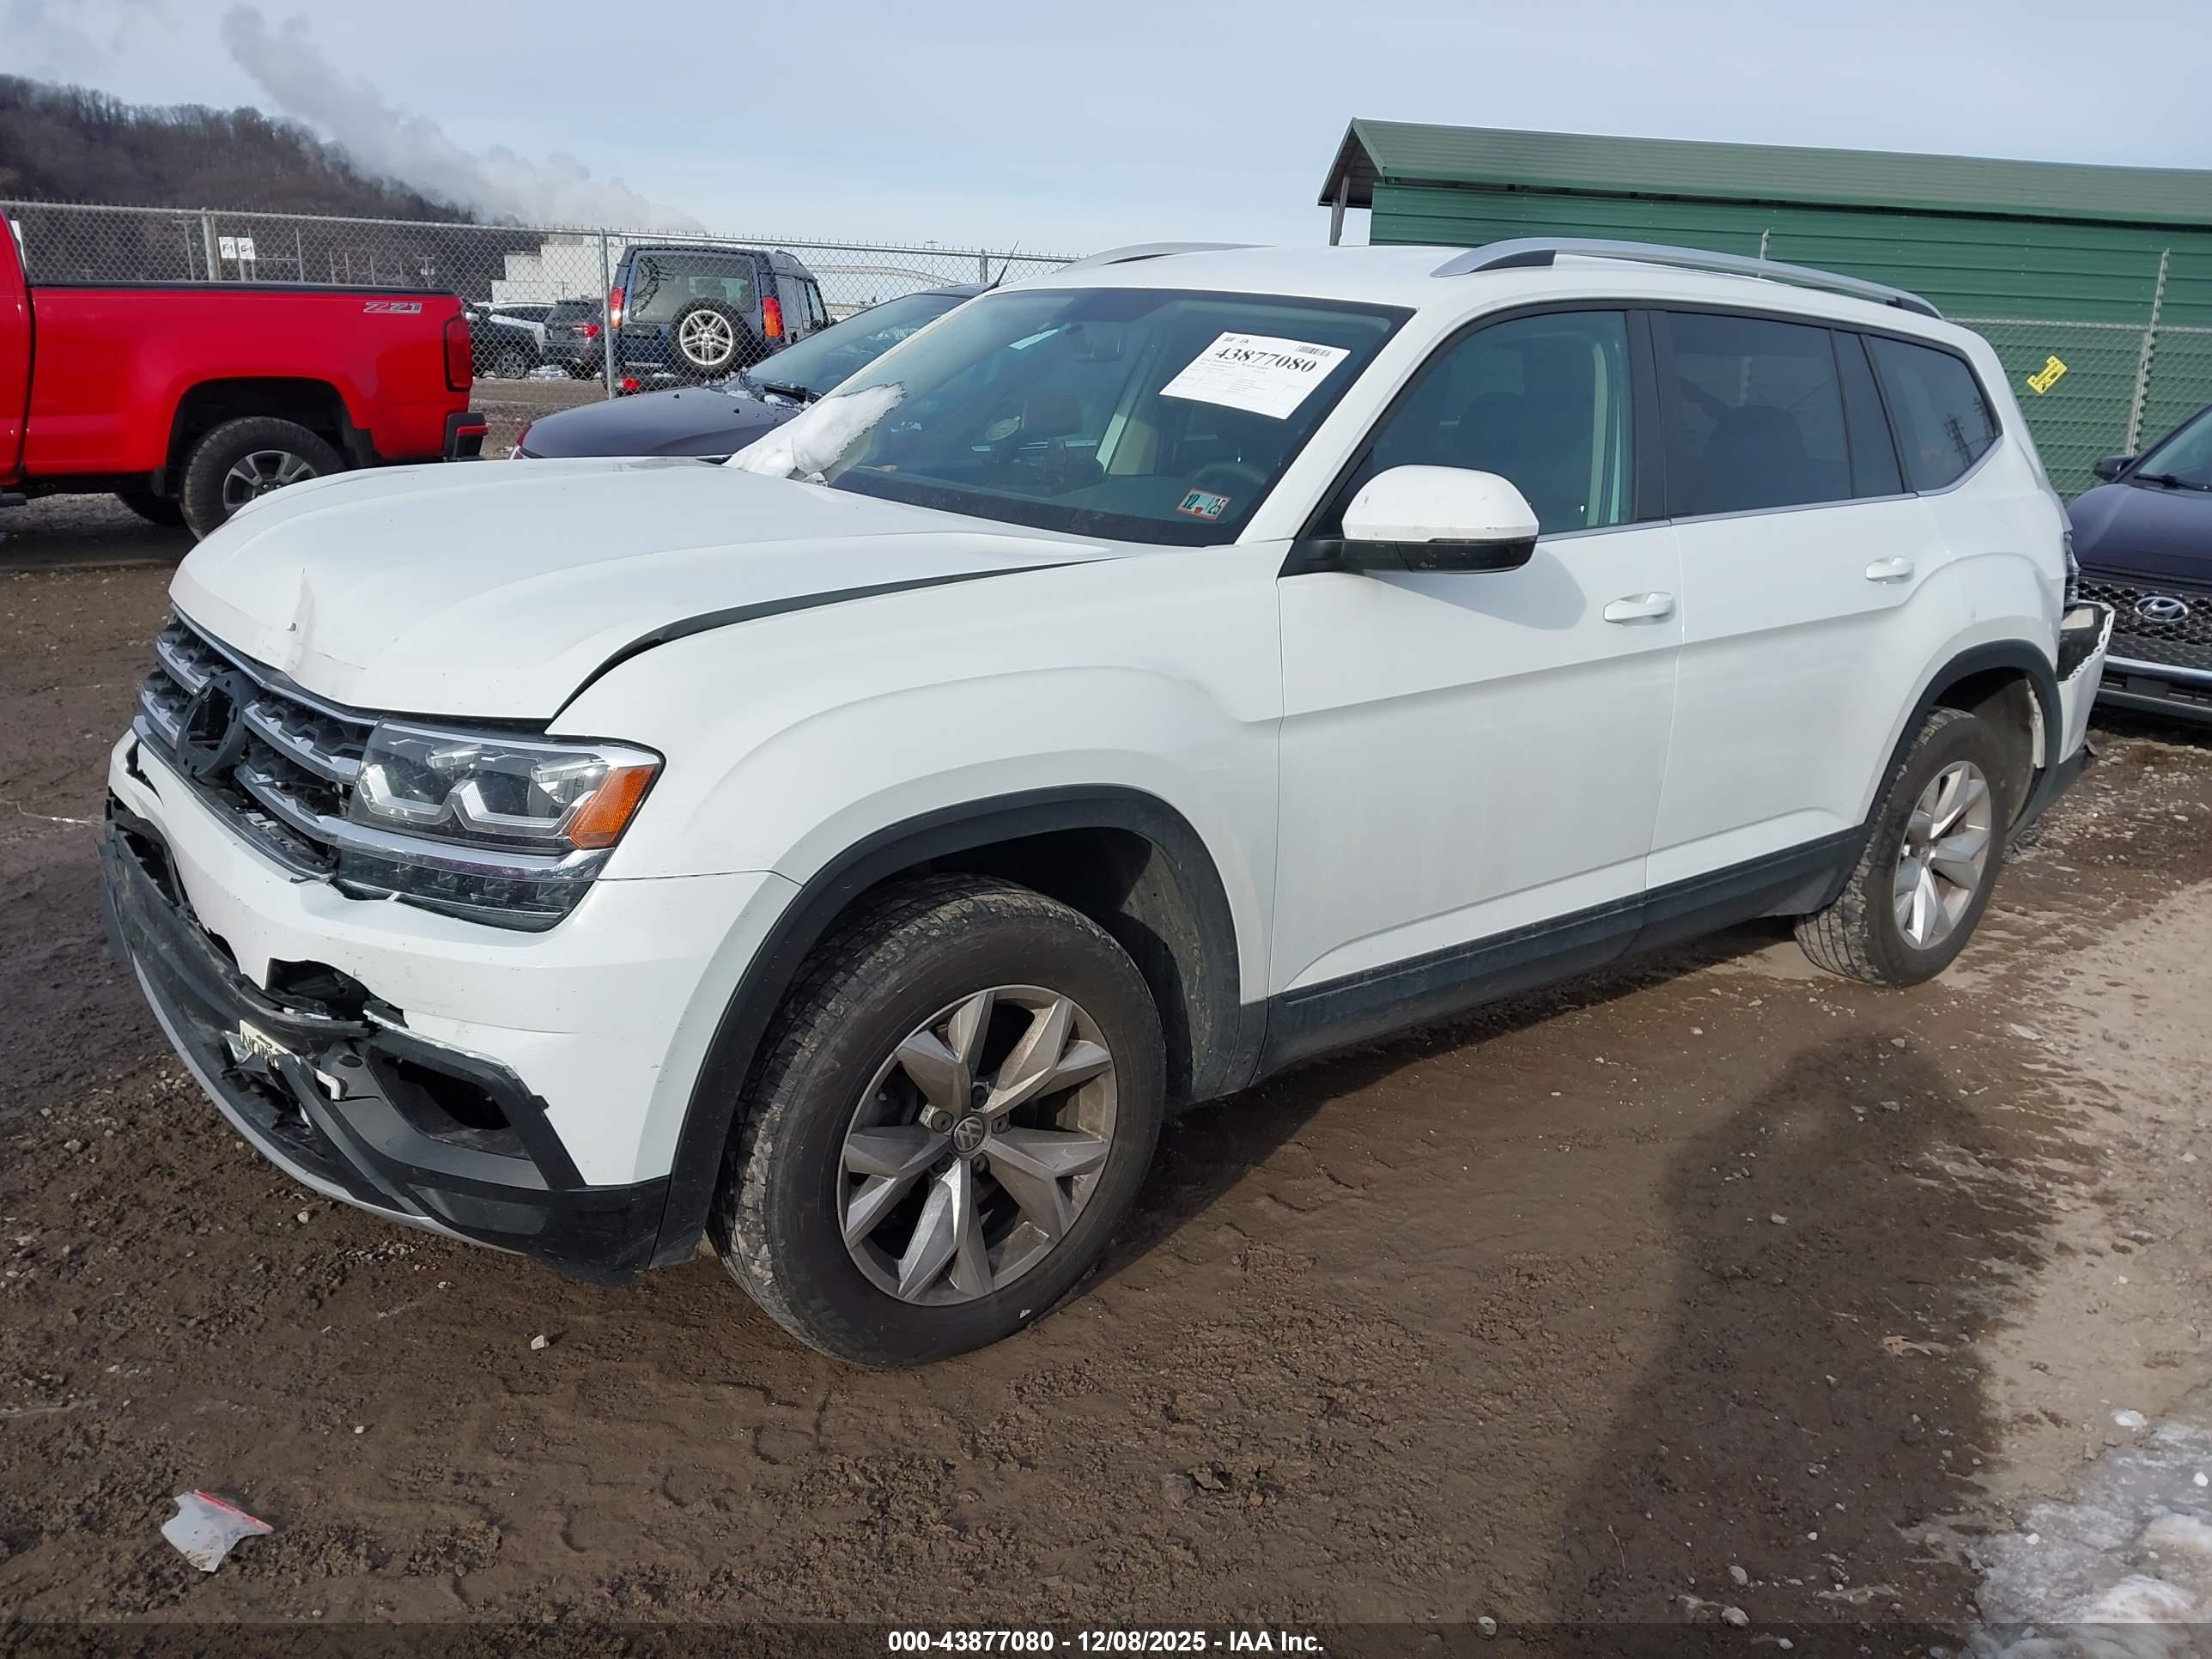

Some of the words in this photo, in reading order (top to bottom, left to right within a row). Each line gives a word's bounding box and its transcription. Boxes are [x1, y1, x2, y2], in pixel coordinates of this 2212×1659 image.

[363, 301, 422, 314] Z71
[1215, 347, 1318, 373] 43877080
[1182, 494, 1200, 510] 12
[1207, 498, 1227, 515] 25
